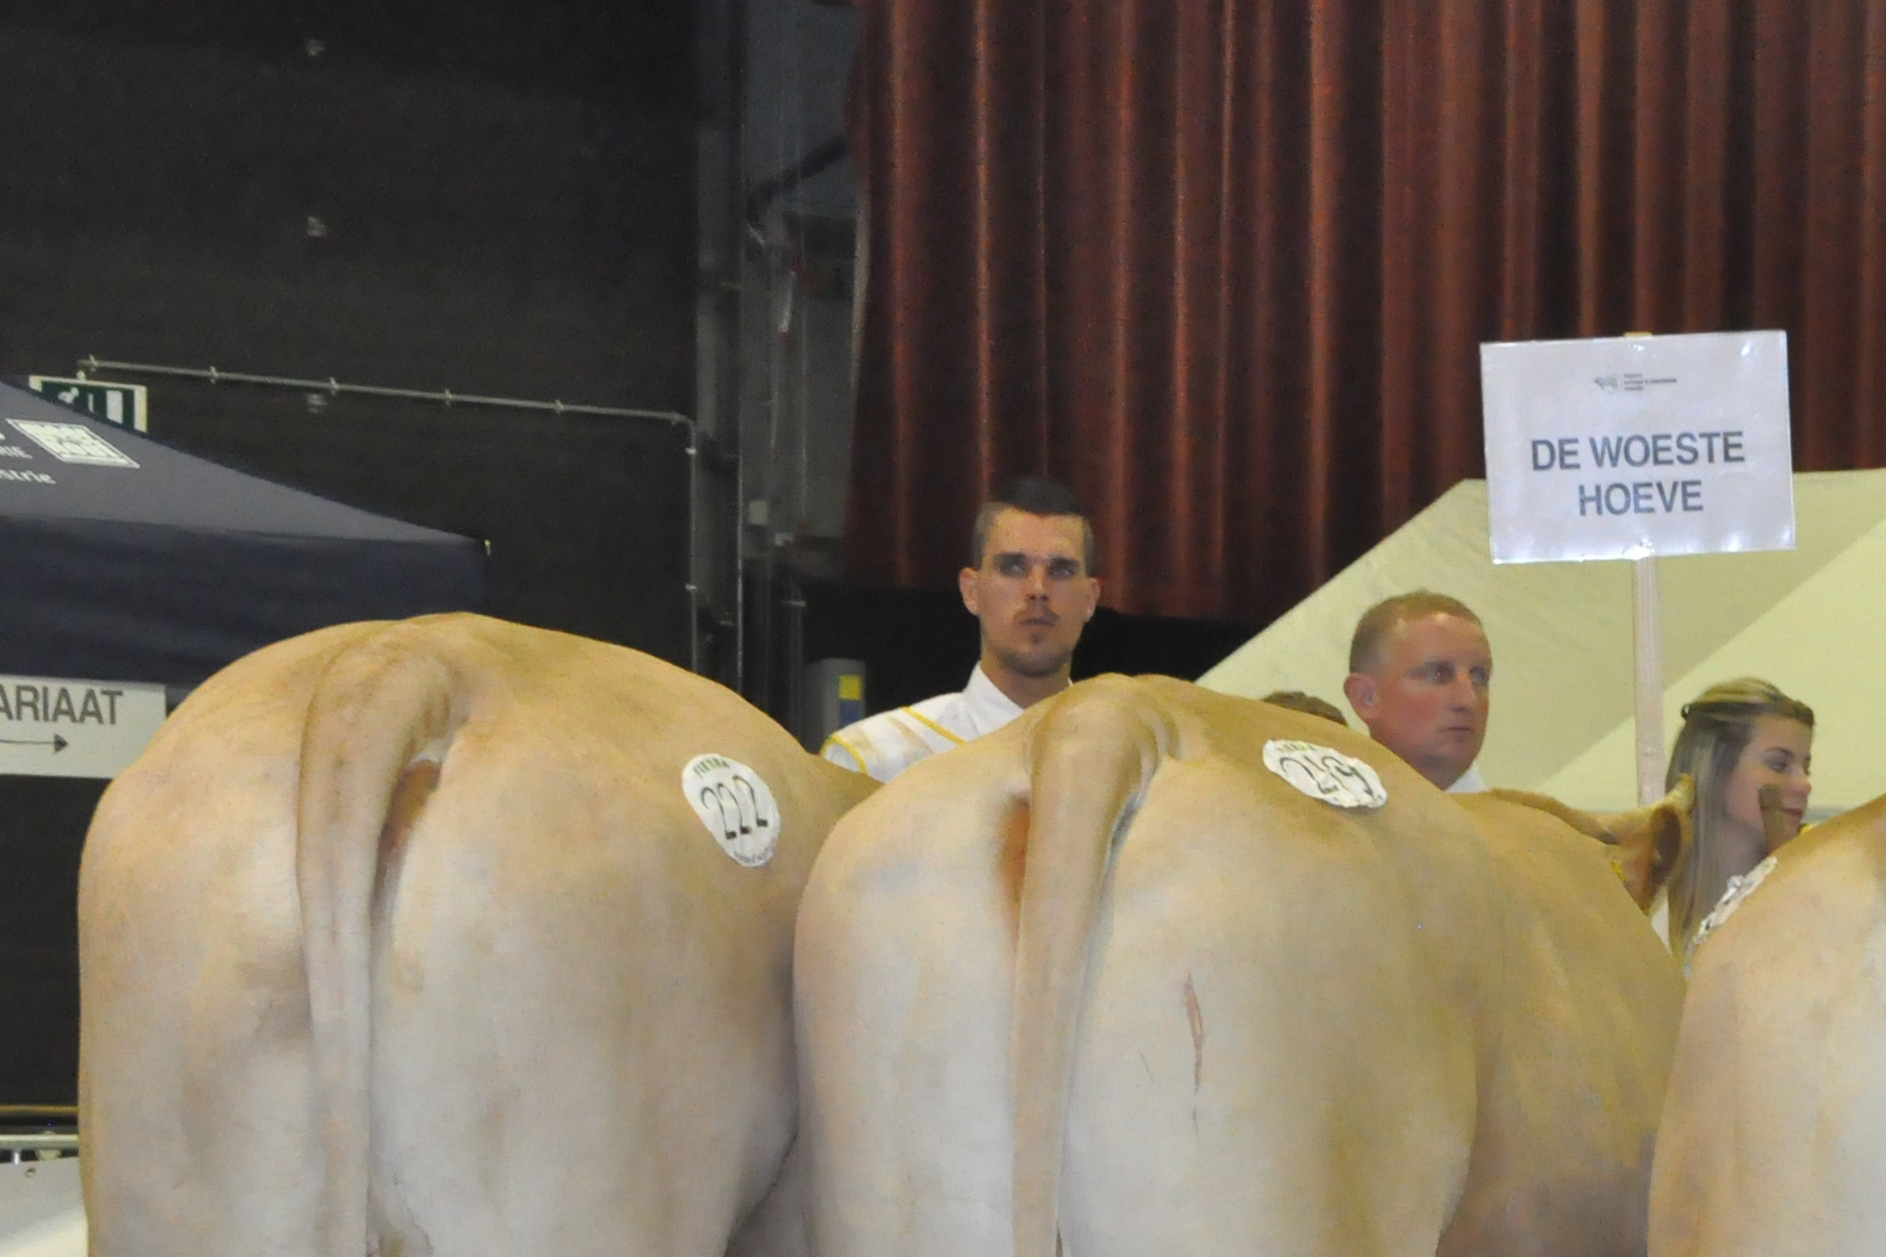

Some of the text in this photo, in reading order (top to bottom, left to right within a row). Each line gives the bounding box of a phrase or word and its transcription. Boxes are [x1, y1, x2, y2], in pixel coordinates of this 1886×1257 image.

[1531, 430, 1746, 472] DE WOESTE
[1578, 479, 1705, 517] HOEVE
